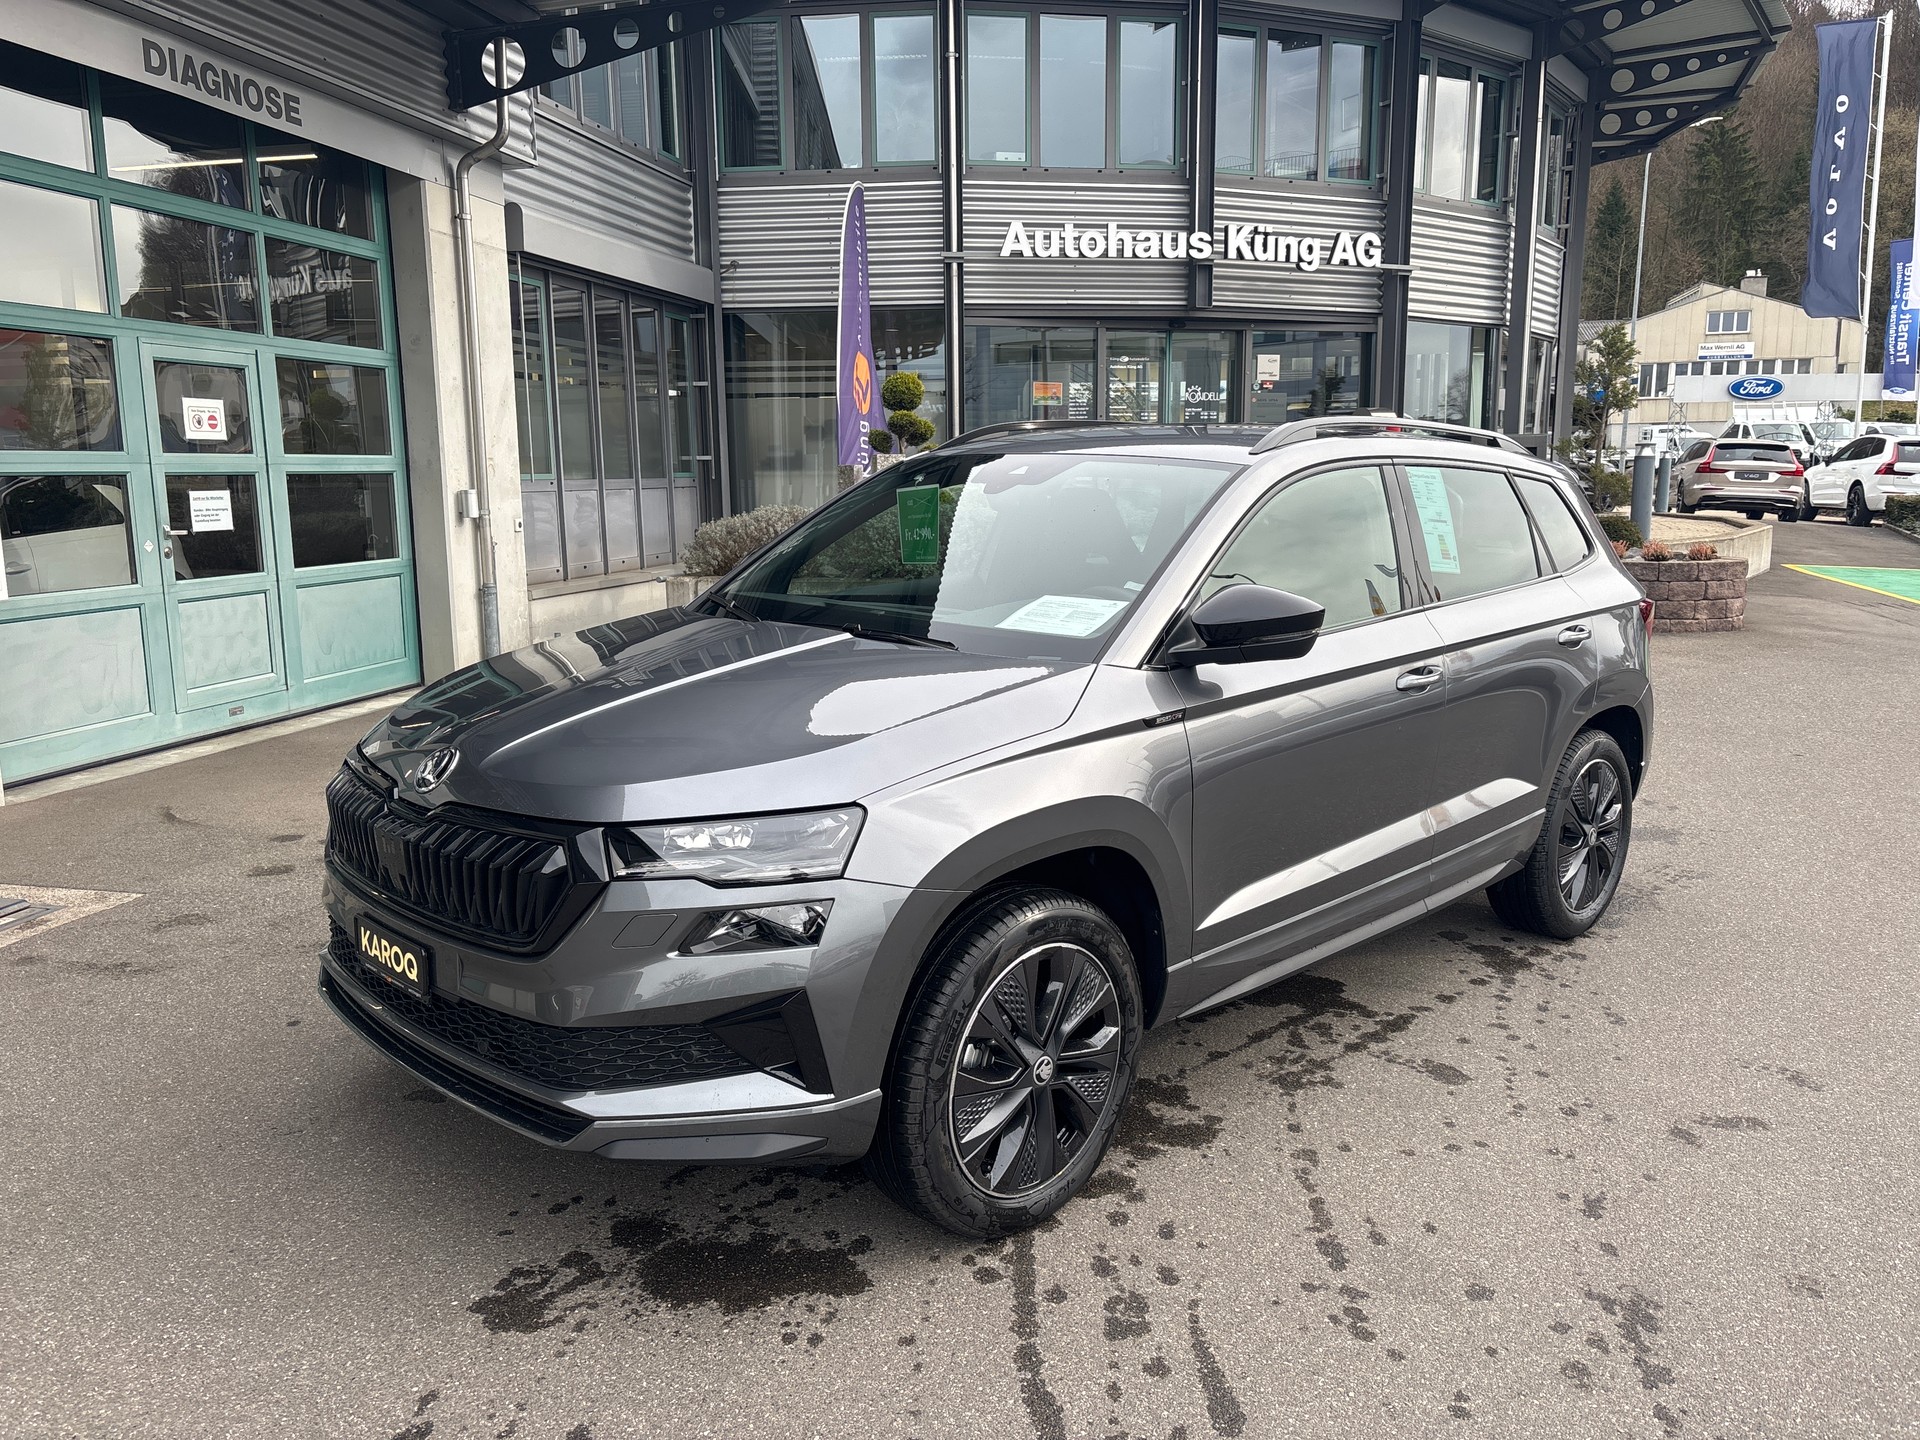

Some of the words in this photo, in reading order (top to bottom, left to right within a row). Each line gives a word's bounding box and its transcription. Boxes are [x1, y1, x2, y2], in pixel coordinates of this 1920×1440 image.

[142, 38, 302, 127] DIAGNOSE
[1000, 220, 1213, 259] Autohaus
[1225, 224, 1321, 272] Küng
[1328, 231, 1382, 268] AG
[1739, 379, 1774, 395] Ford
[361, 926, 418, 982] KAROQ
